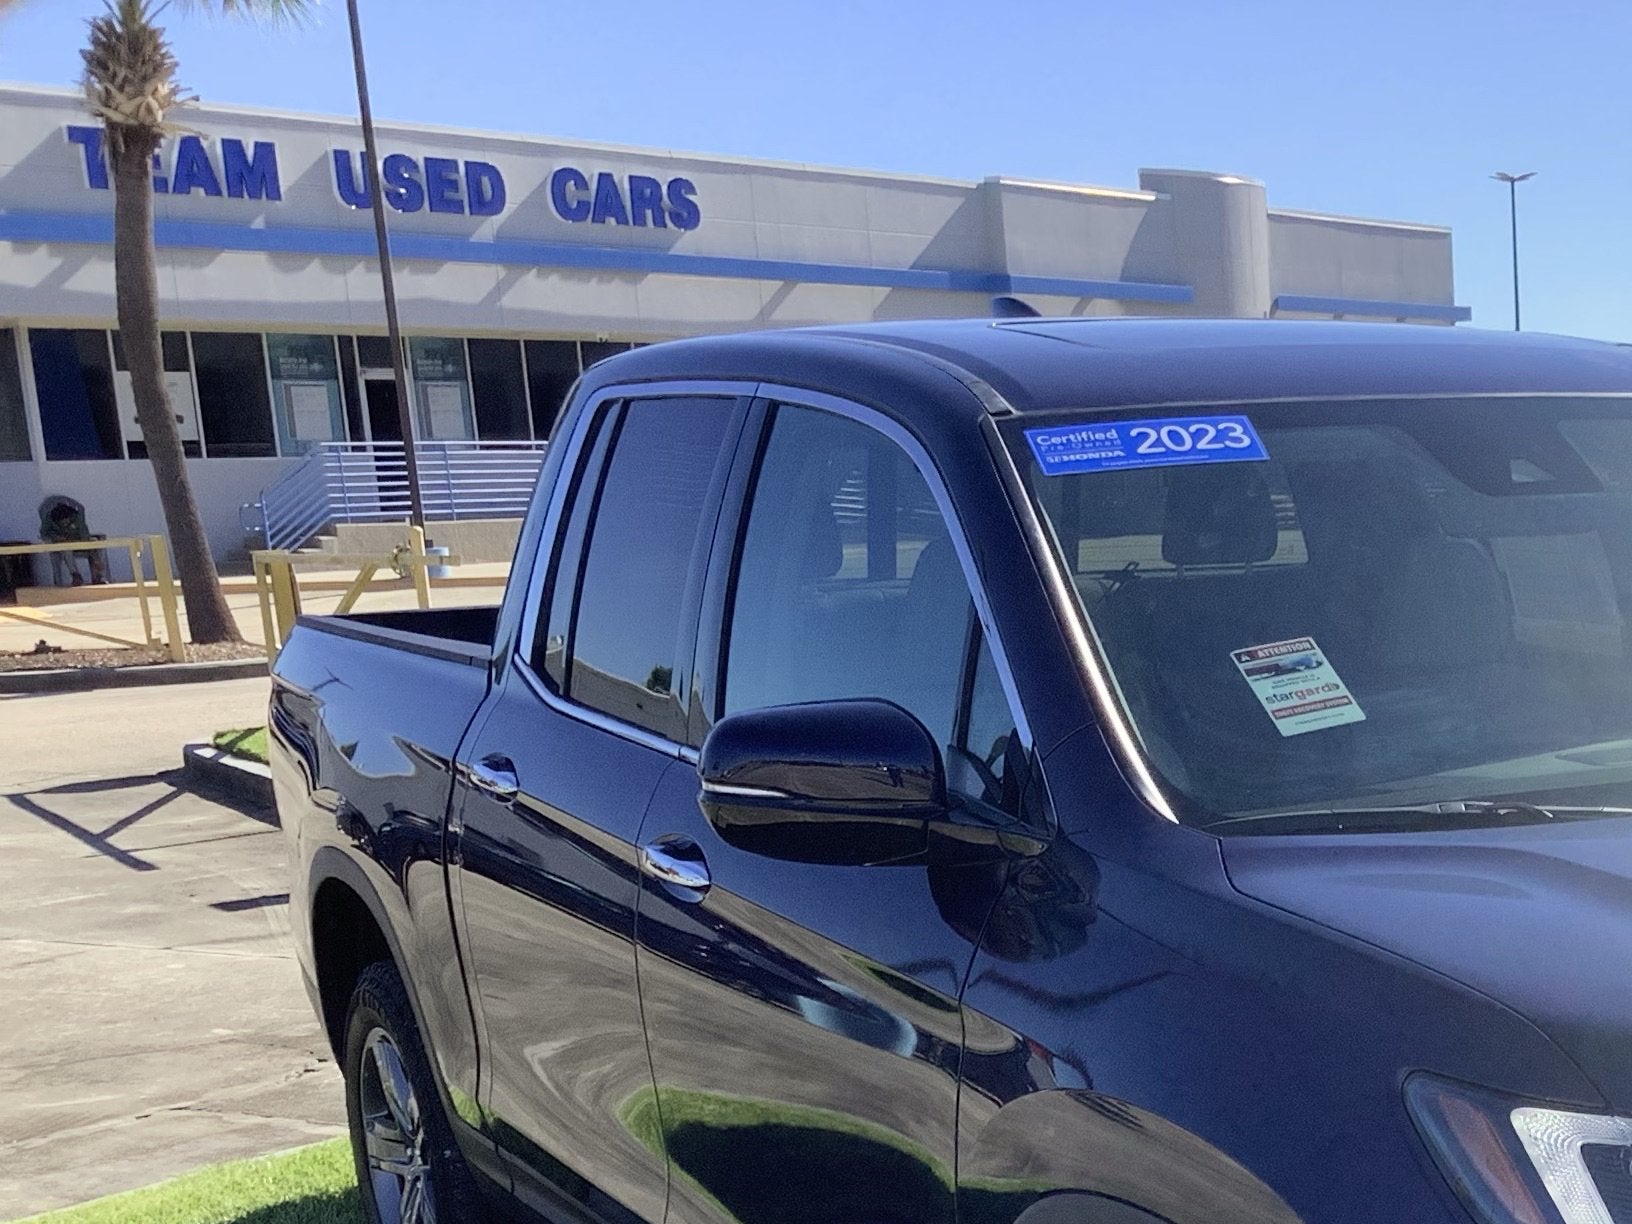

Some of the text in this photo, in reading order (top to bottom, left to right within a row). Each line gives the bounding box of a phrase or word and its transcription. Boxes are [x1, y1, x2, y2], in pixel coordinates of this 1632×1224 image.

[67, 124, 701, 231] TAM USED CARS
[1036, 428, 1119, 446] Certified
[1129, 421, 1251, 455] 2023
[1062, 450, 1127, 462] HONDA
[1257, 641, 1312, 659] ATTENTION
